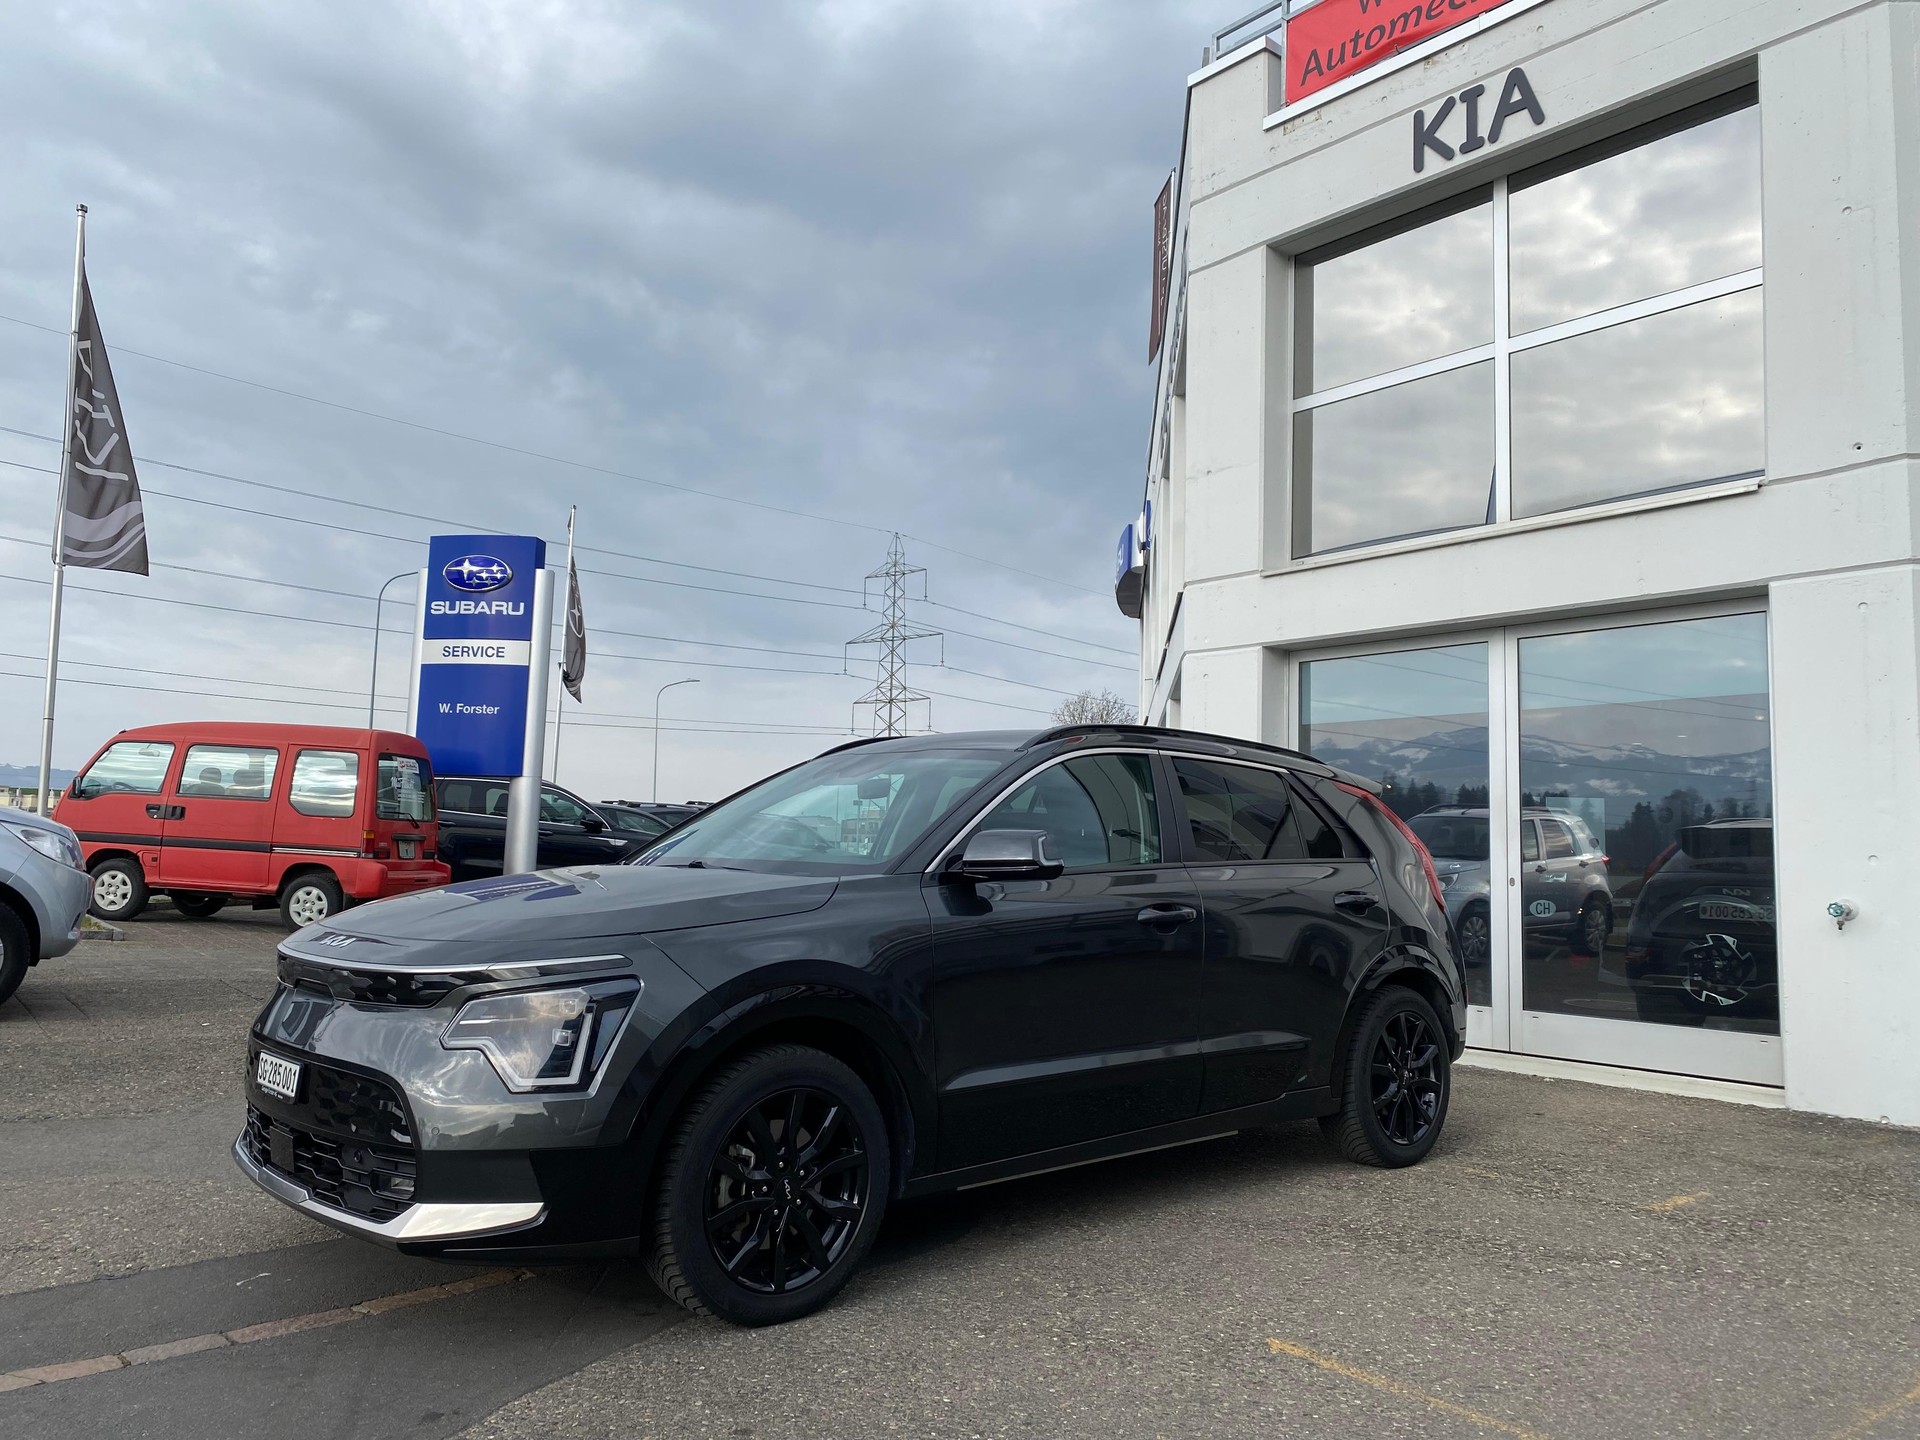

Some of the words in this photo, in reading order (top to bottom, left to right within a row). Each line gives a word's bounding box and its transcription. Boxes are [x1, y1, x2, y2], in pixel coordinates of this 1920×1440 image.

[1301, 0, 1483, 86] Automec
[1413, 67, 1545, 173] KIA
[430, 600, 525, 616] SUBARU
[442, 645, 506, 658] SERVICE
[438, 703, 453, 714] W.
[456, 703, 500, 715] Forster
[1535, 902, 1551, 915] CH
